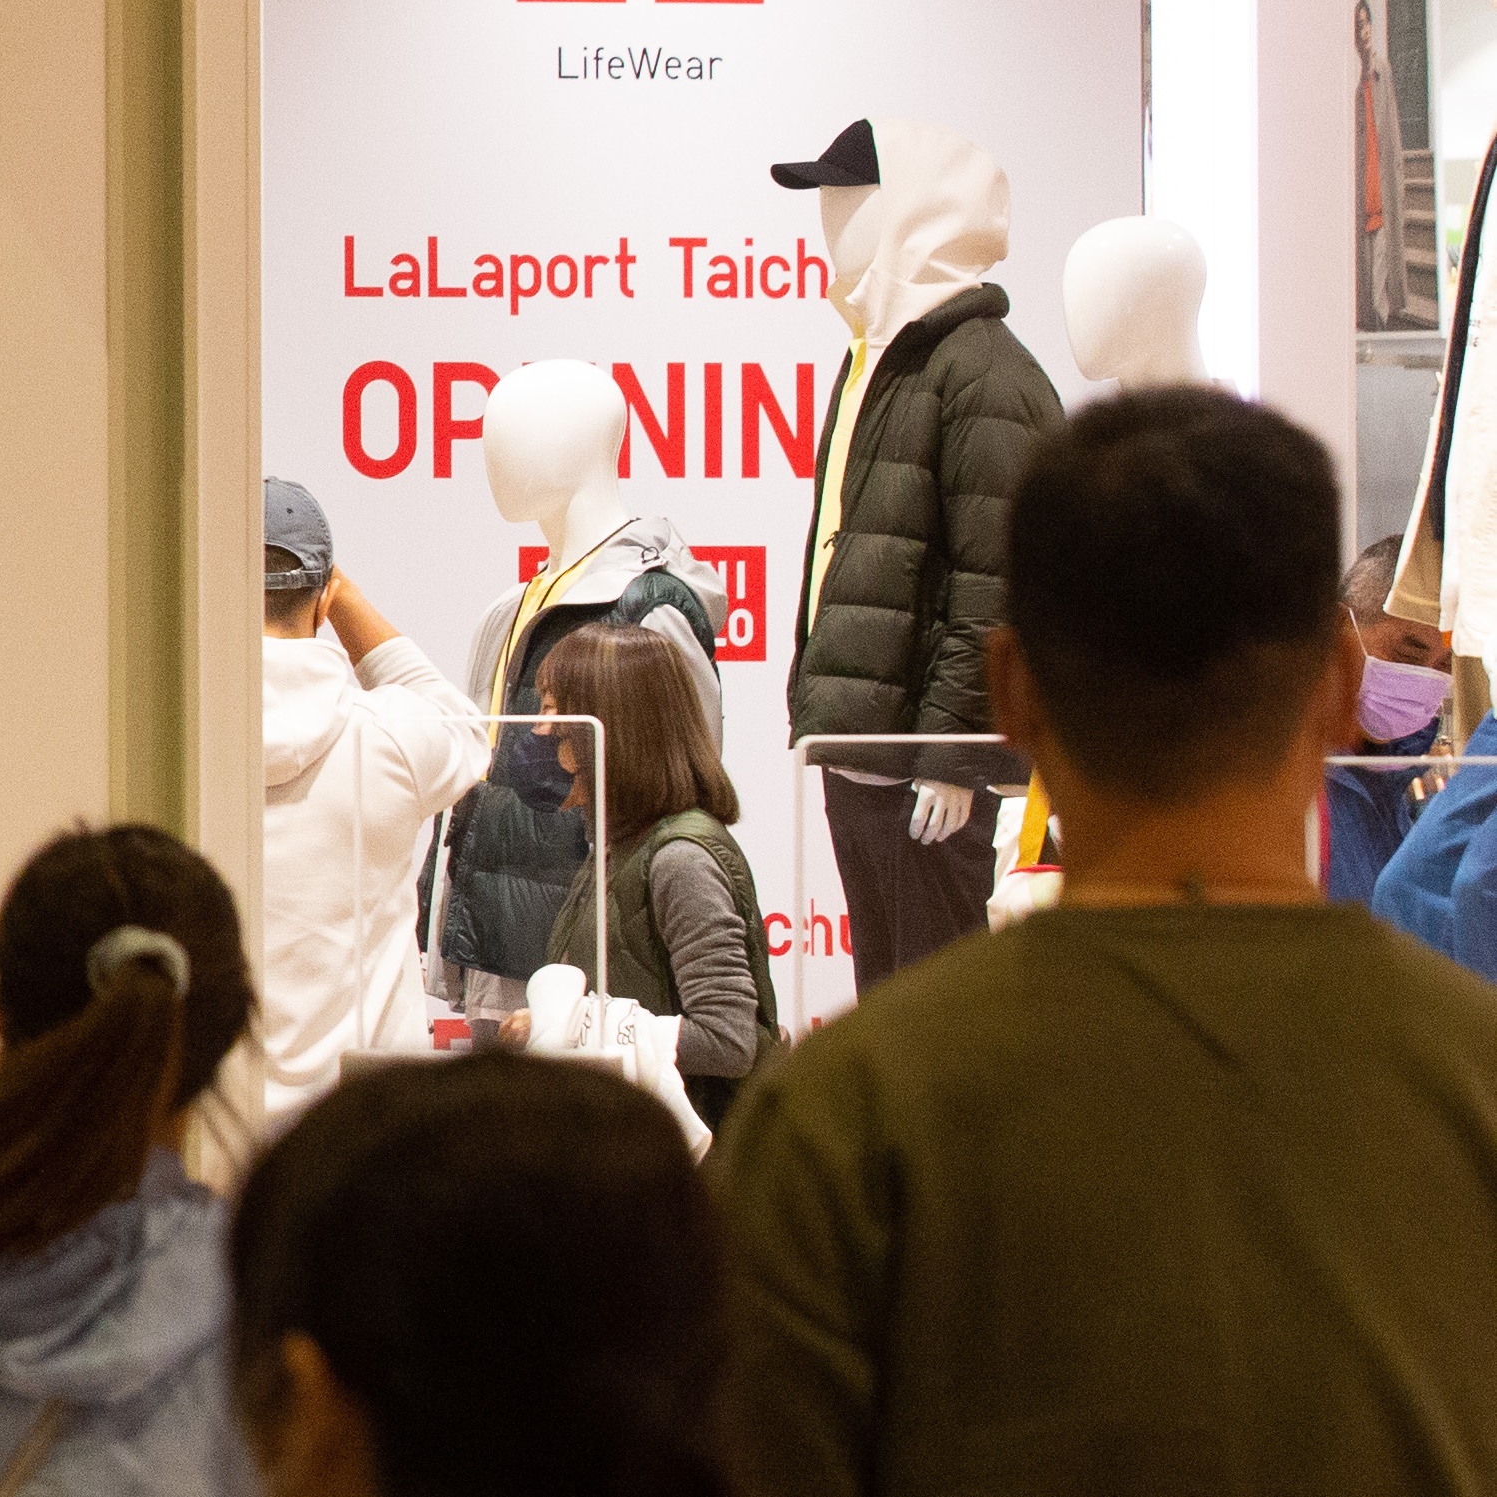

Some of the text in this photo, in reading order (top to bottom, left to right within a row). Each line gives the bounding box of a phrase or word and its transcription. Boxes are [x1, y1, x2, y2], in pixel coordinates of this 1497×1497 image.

[557, 46, 724, 82] LifeWear
[343, 235, 831, 316] LaLaport Taich
